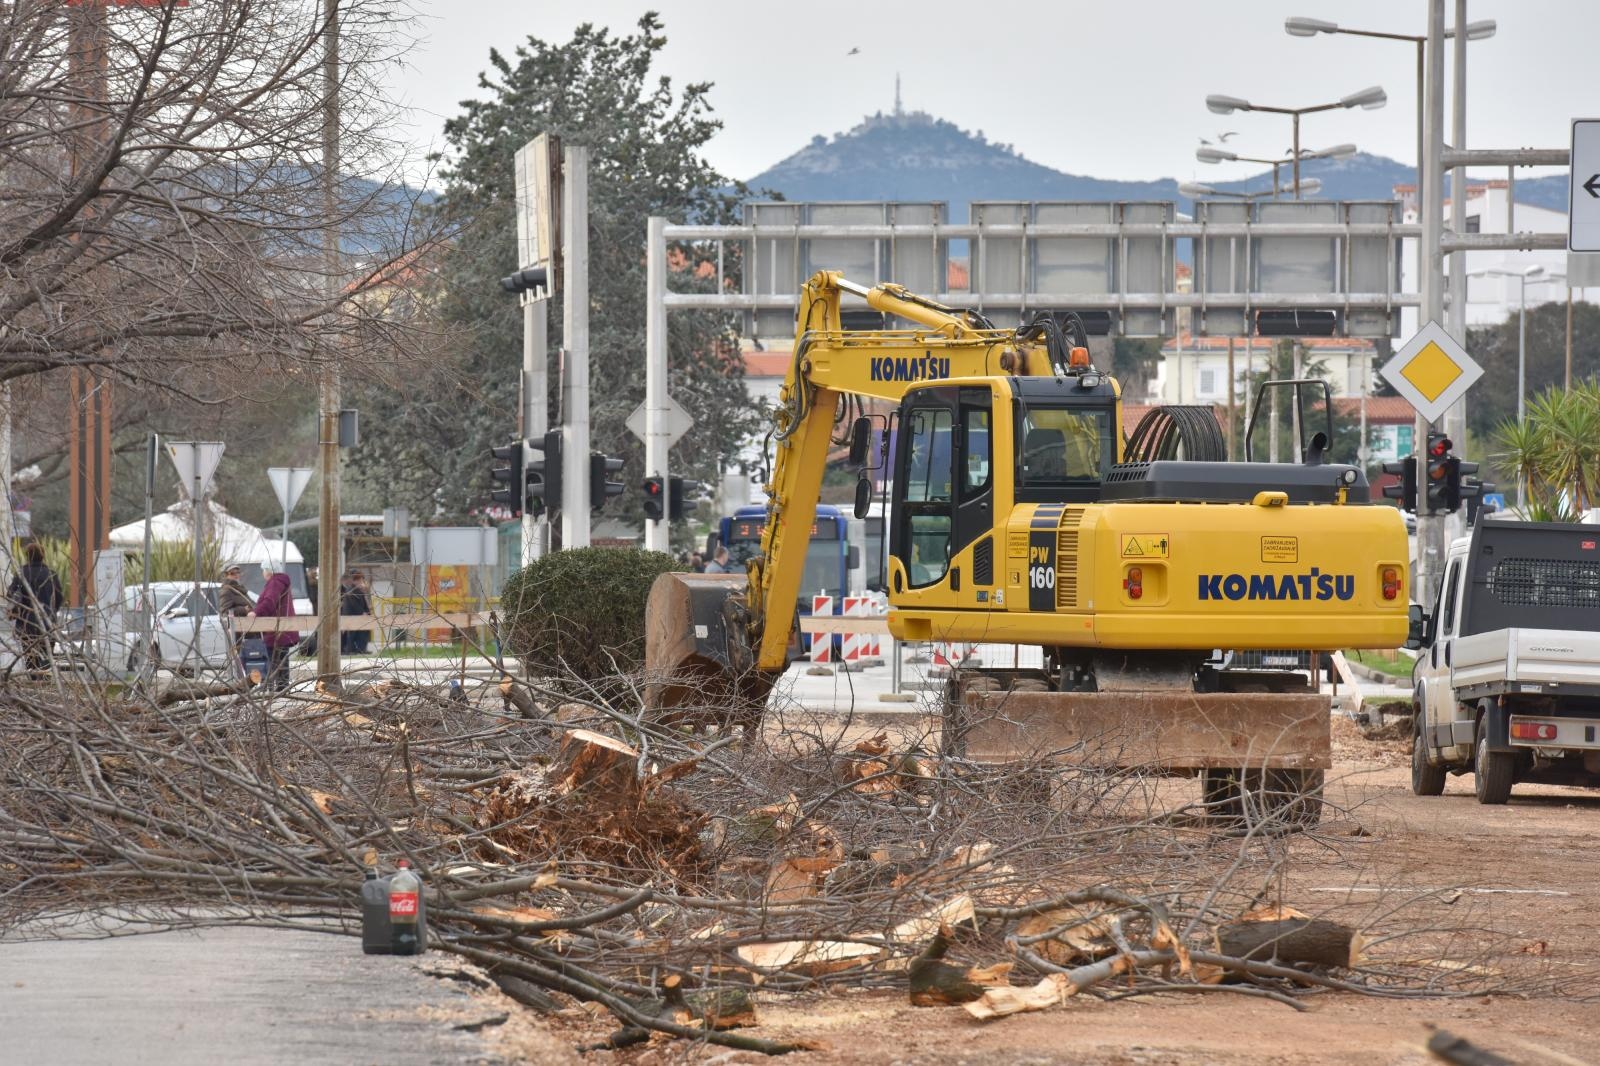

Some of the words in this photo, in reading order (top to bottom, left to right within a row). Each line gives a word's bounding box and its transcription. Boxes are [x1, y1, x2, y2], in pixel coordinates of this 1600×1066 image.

[870, 351, 950, 381] KOMATSU
[1030, 546, 1049, 564] PW
[1029, 566, 1055, 589] 160
[1198, 567, 1354, 601] KOMATSU
